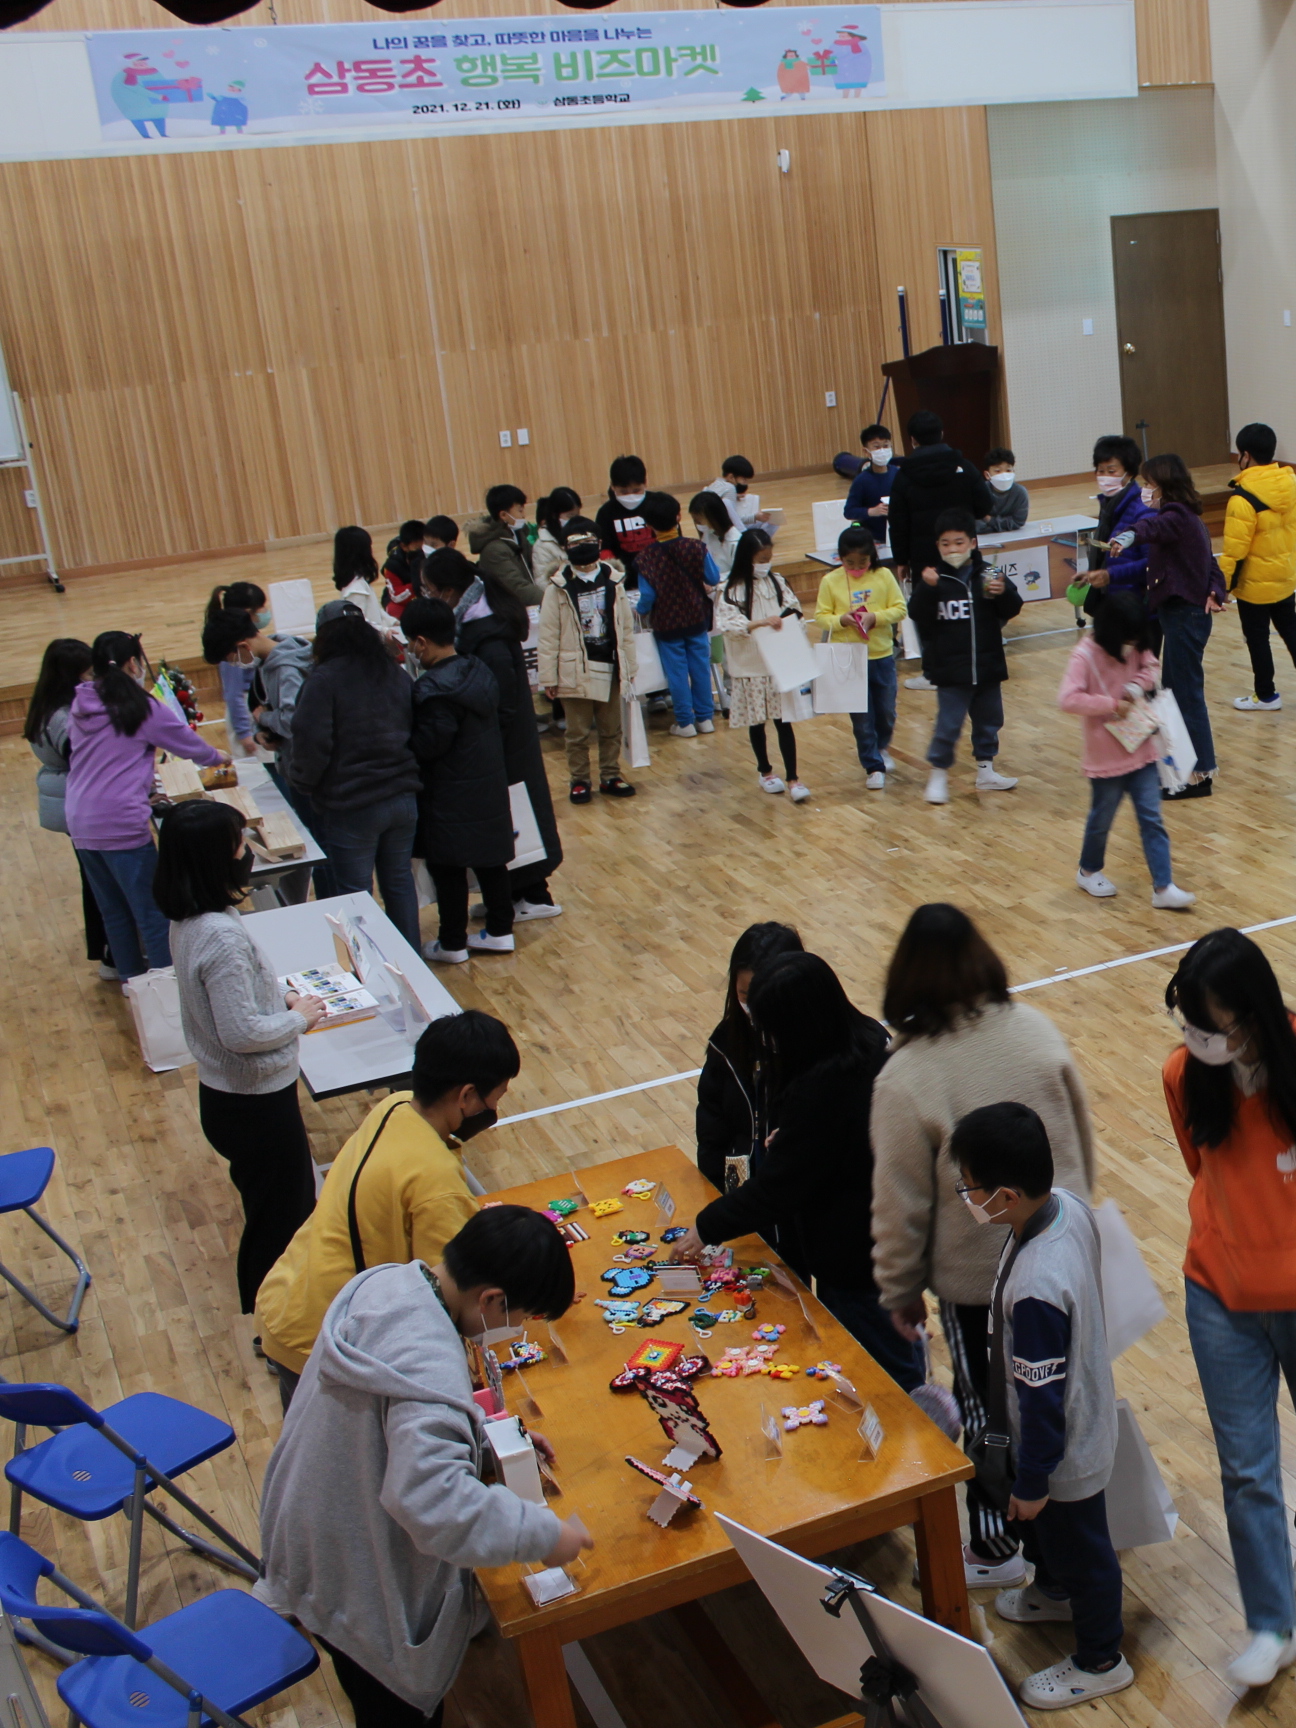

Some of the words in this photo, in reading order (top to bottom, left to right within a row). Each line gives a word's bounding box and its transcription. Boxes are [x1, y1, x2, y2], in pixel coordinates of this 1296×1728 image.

[373, 36, 409, 50] 나의
[412, 34, 448, 49] 꿈을
[452, 33, 491, 47] 찾고,
[495, 30, 546, 46] 따뜻한
[550, 28, 600, 43] 마음을
[604, 26, 653, 40] 나누는
[304, 55, 444, 96] 삼동초
[453, 52, 543, 88] 행복
[553, 44, 719, 82] 비즈마켓
[412, 105, 449, 115] 2021.
[452, 103, 472, 112] 12.
[475, 102, 494, 111] 21.
[553, 93, 630, 107] 삼동초등학교
